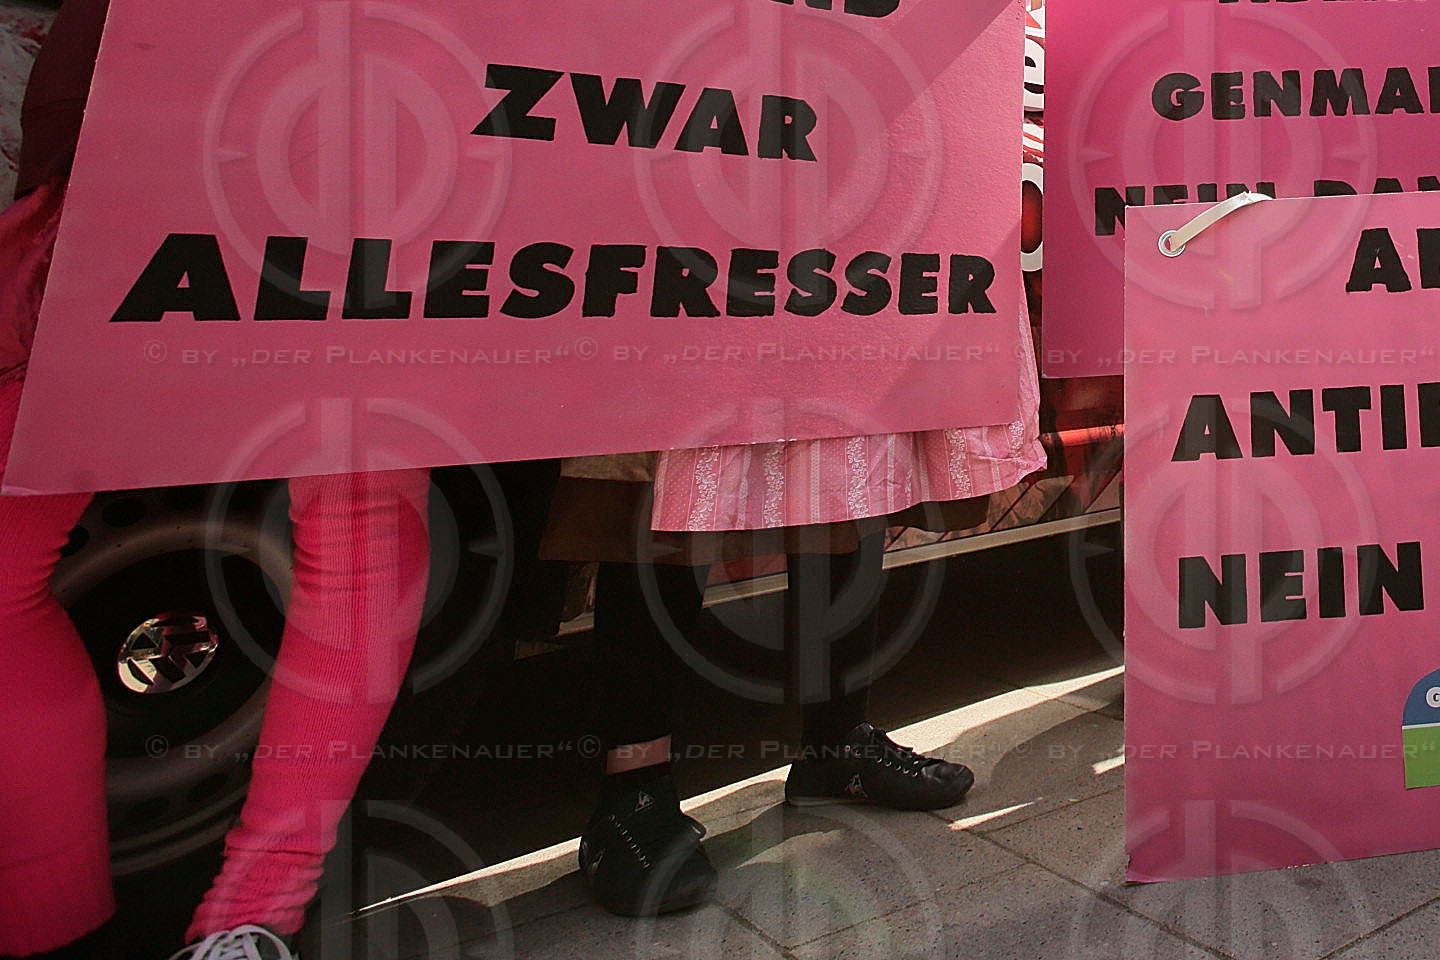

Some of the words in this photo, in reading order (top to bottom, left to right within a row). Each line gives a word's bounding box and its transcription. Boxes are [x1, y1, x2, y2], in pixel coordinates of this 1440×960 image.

[471, 64, 817, 161] ZWAR
[109, 233, 996, 322] ALLESFRESSER
[1179, 542, 1424, 628] NEIN
